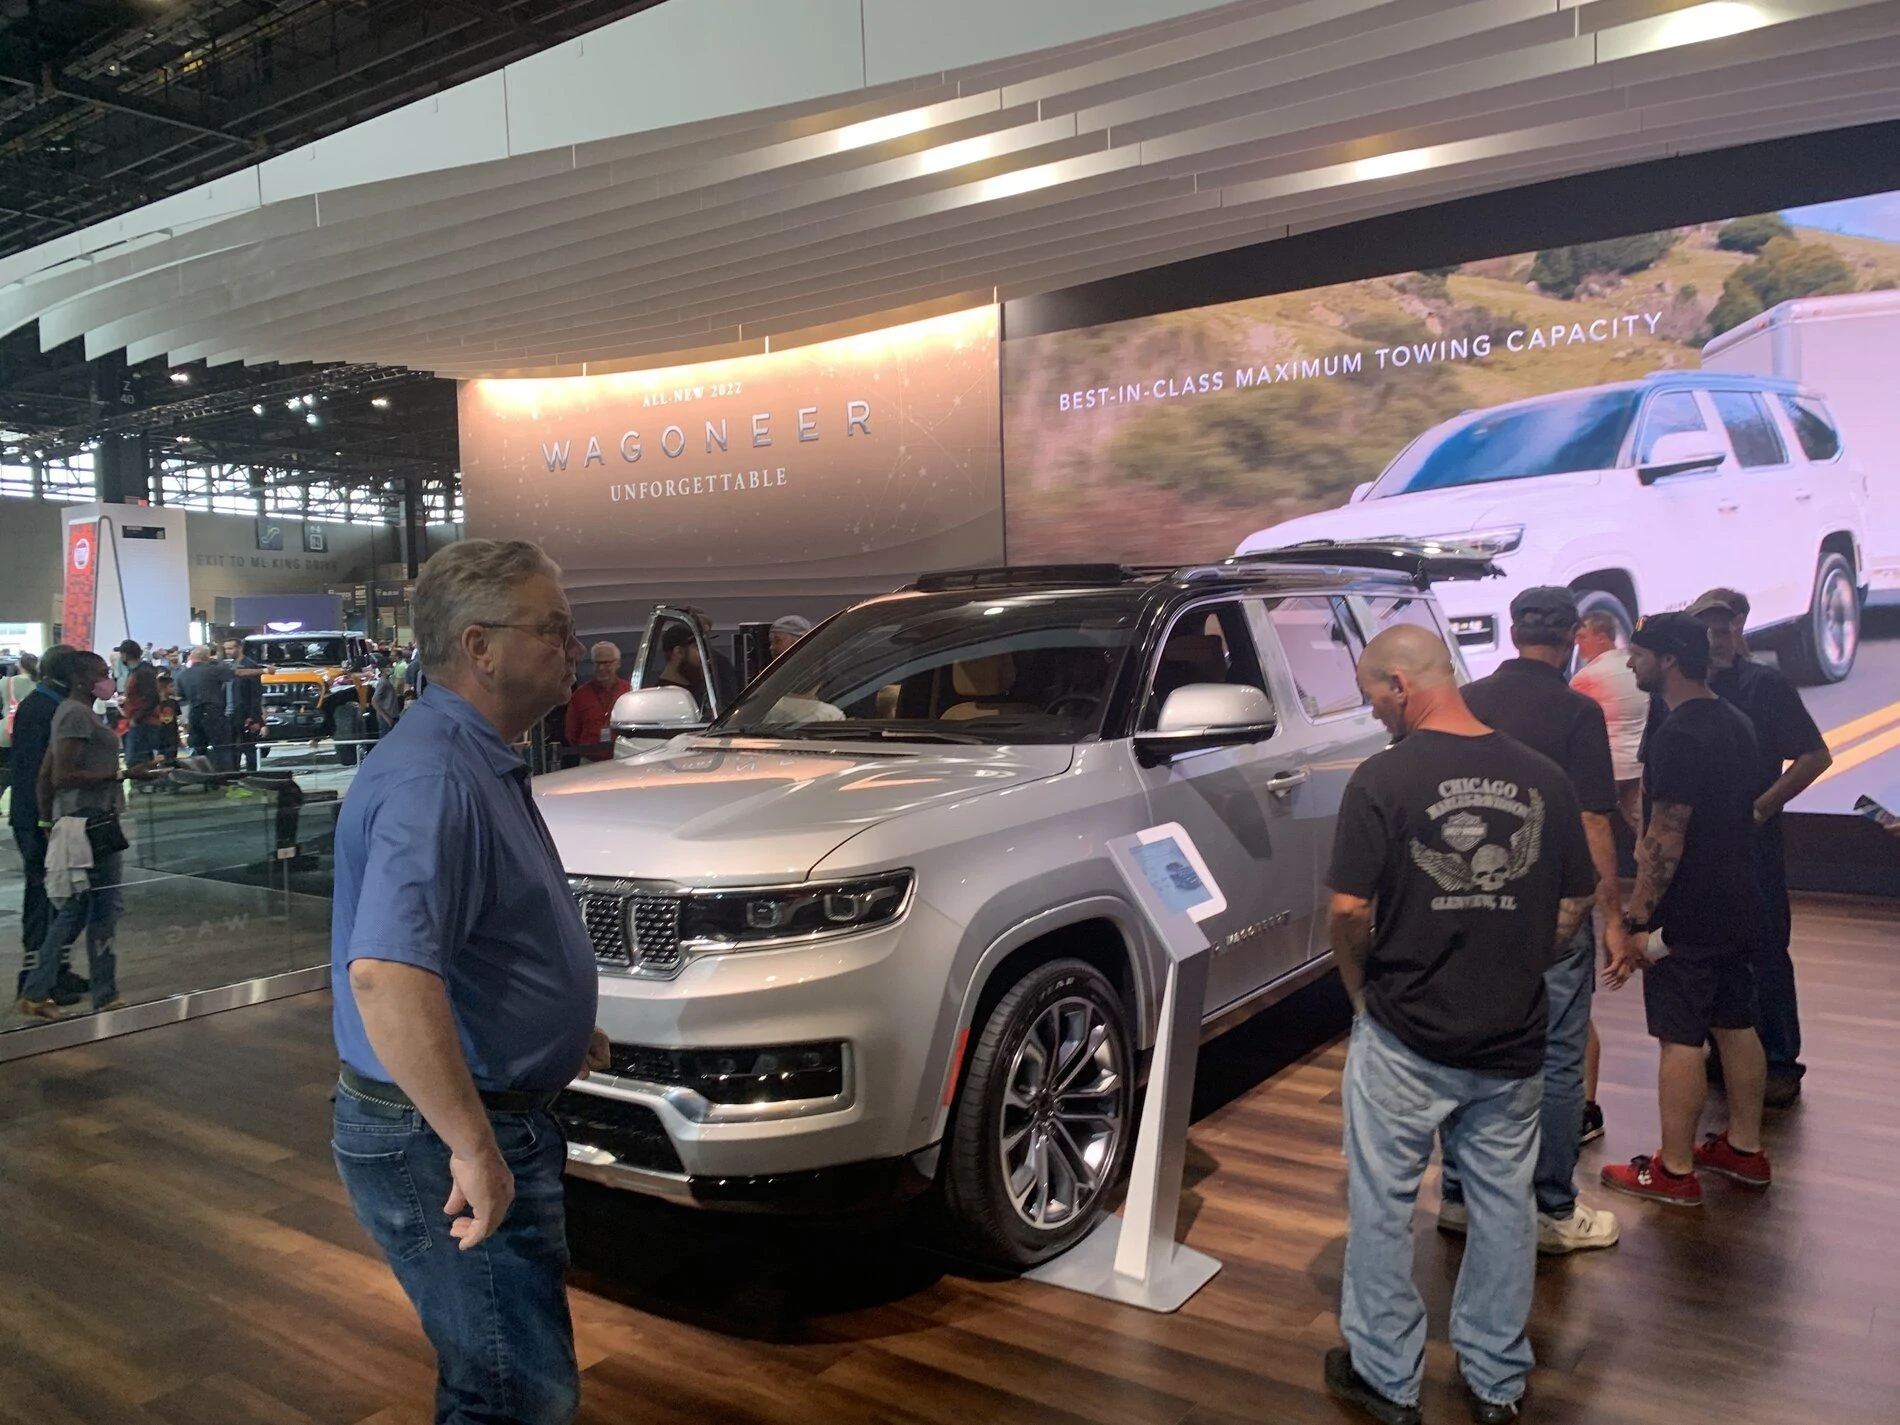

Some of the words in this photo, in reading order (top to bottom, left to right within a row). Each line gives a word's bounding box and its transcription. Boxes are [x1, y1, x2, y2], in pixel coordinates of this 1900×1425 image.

[1060, 371, 1224, 411] BEST-IN-CLASS
[1236, 352, 1362, 388] MAXIMUM
[1375, 334, 1491, 369] TOWING
[1506, 312, 1662, 351] CAPACITY
[710, 381, 742, 398] 2022
[541, 399, 871, 472] WAGONEER
[610, 467, 788, 502] UNFORGETTABLE
[196, 555, 225, 567] EXIT
[230, 555, 245, 568] TO
[272, 557, 301, 570] KING
[1438, 777, 1519, 799] CHICAGO
